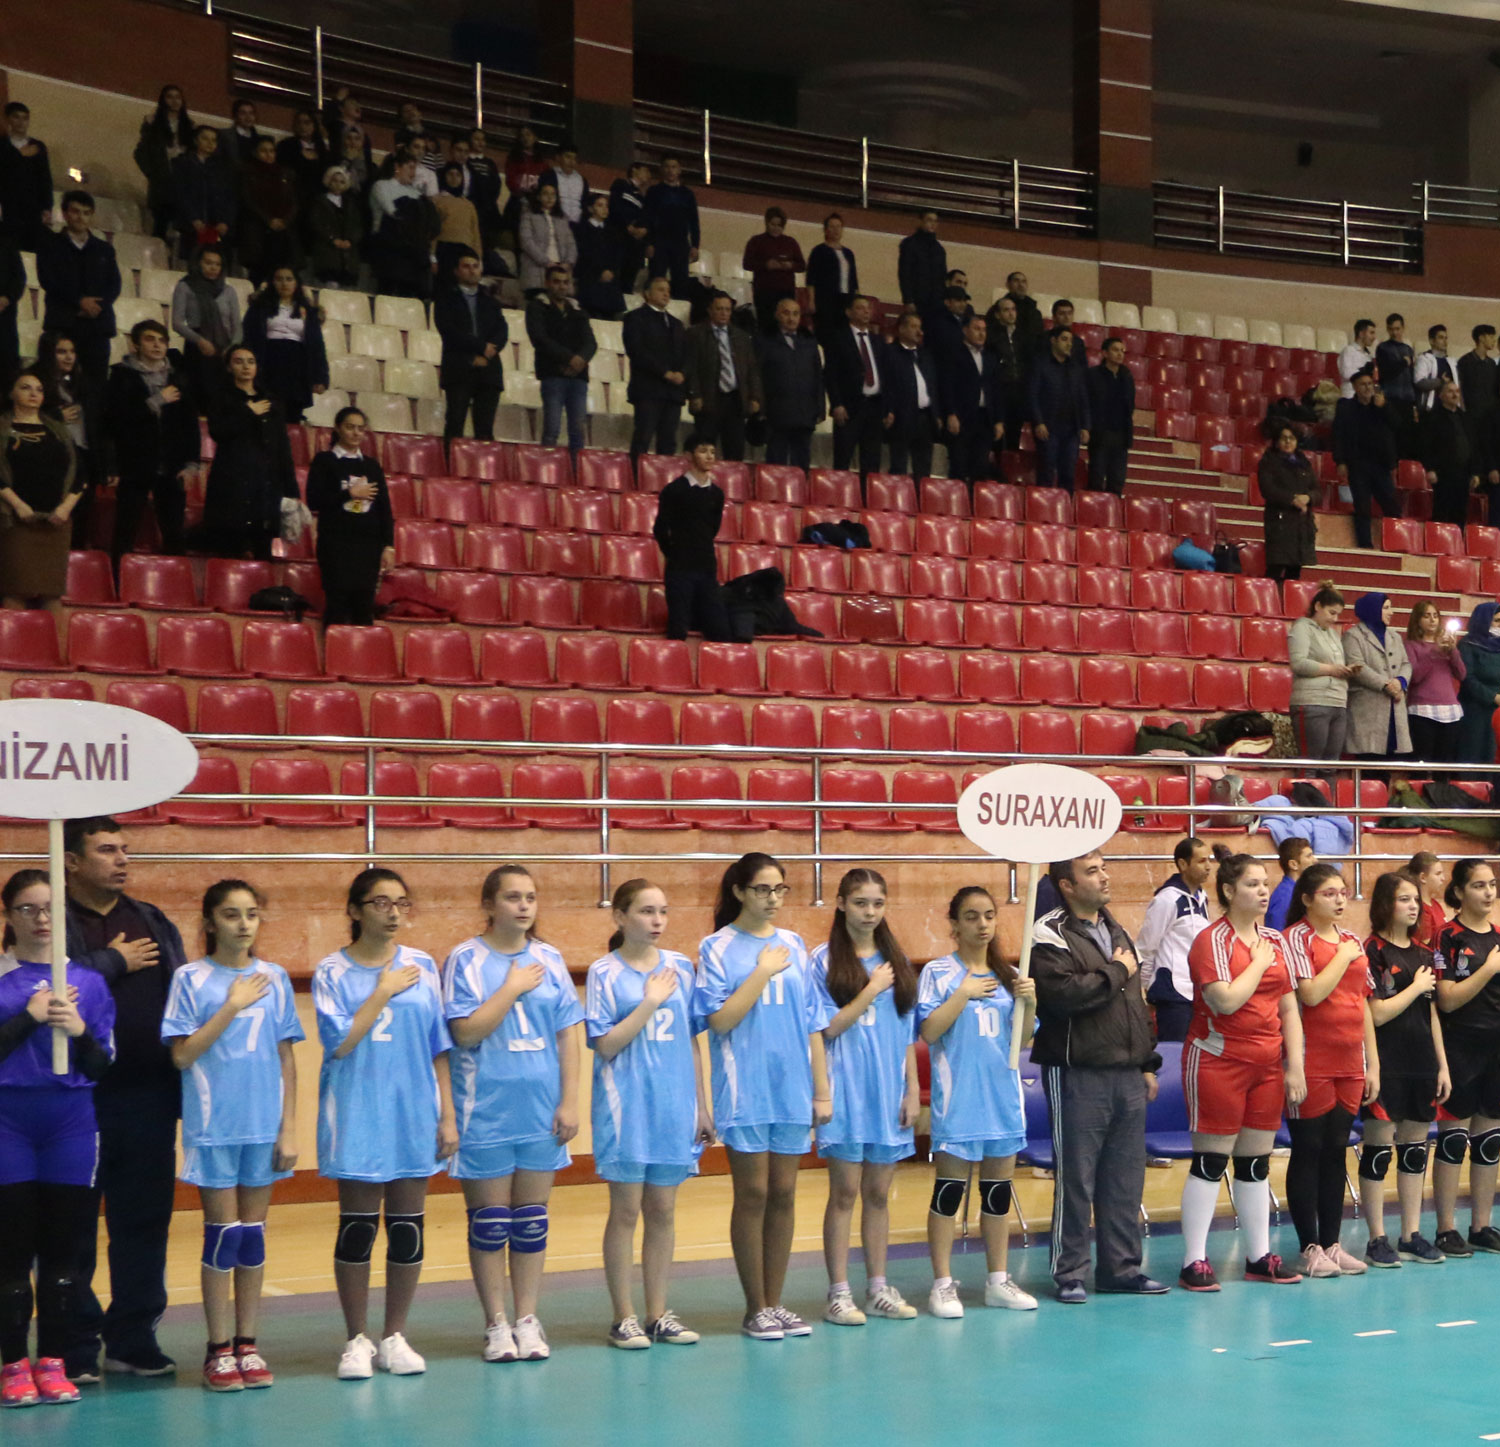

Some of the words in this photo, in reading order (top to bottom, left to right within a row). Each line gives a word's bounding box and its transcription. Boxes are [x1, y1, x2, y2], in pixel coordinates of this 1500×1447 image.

[977, 792, 1105, 830] SURAXANI
[762, 972, 784, 1005] 11
[235, 1007, 265, 1052] 7
[371, 1006, 394, 1041] 2
[647, 1008, 675, 1041] 12
[974, 1003, 1000, 1038] 10
